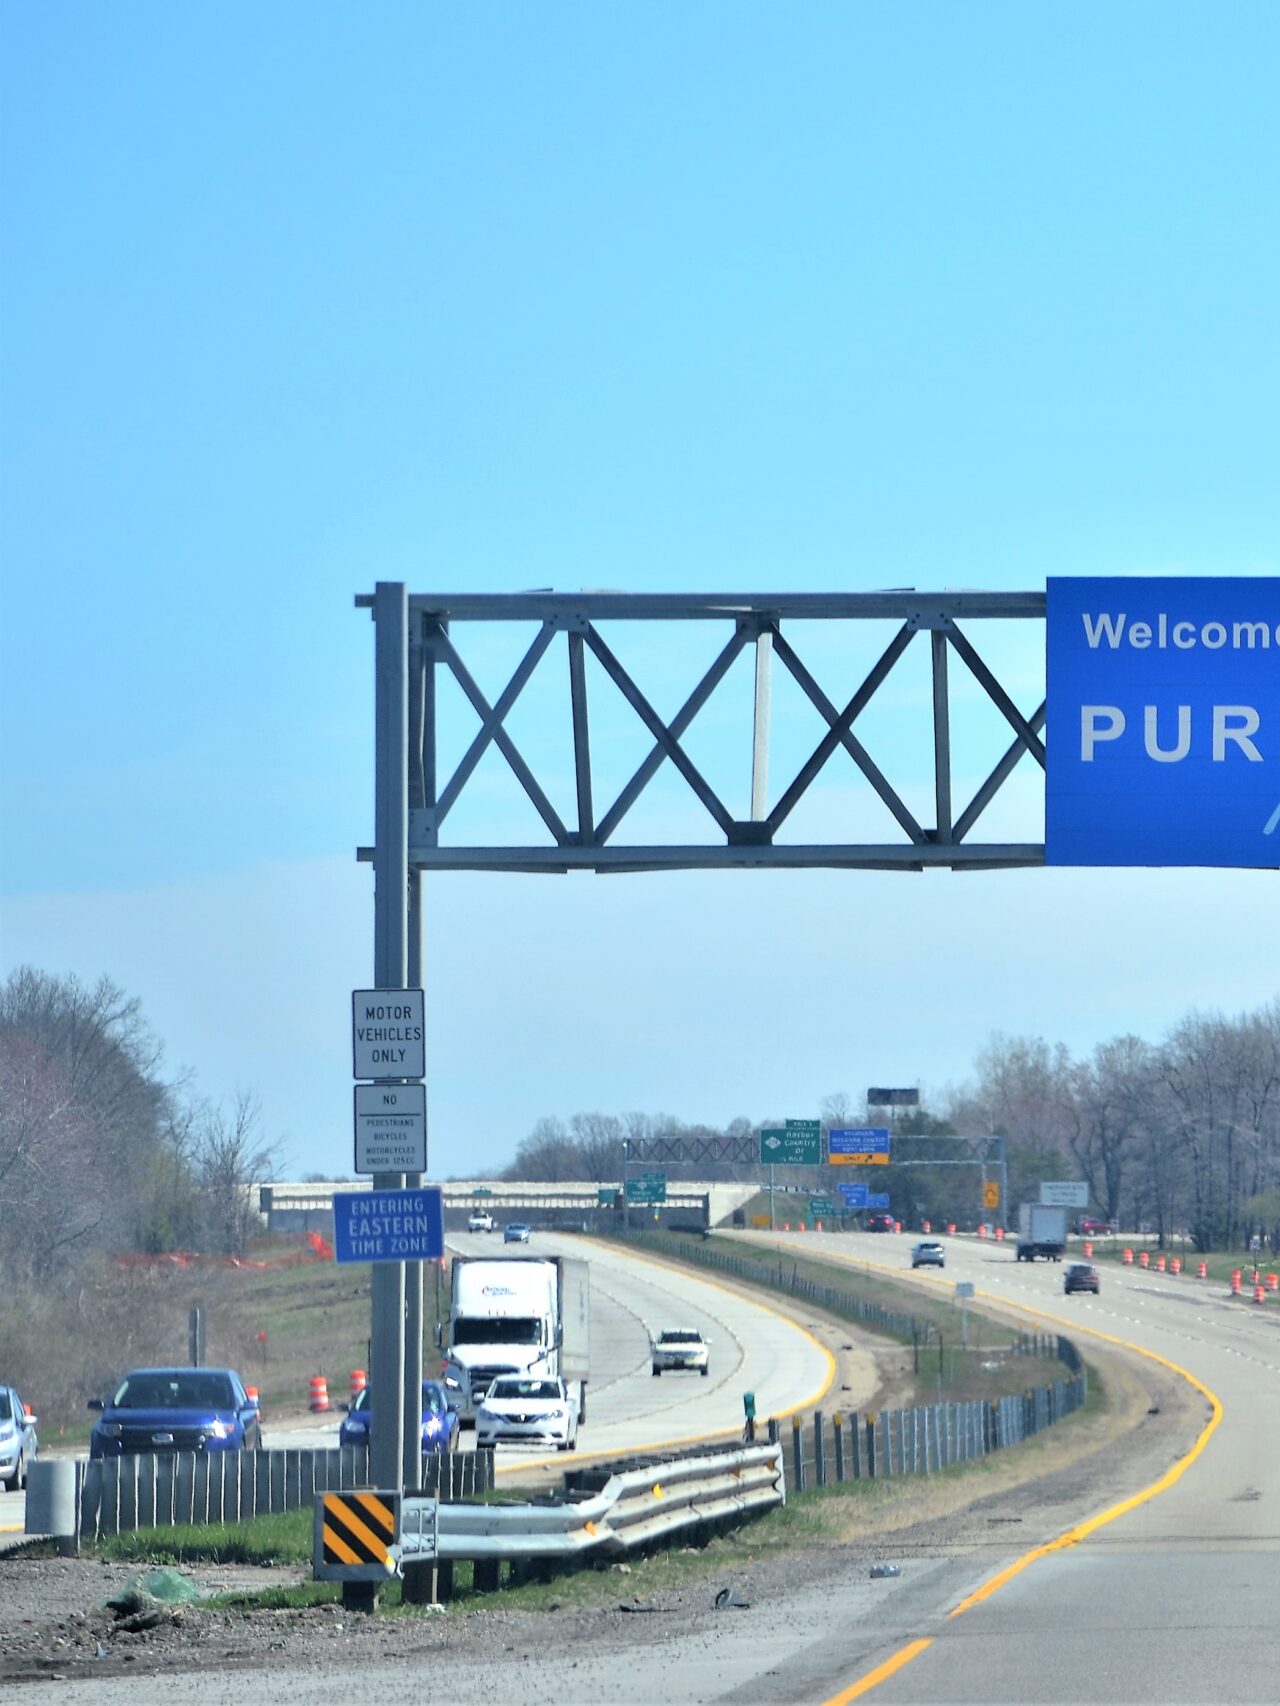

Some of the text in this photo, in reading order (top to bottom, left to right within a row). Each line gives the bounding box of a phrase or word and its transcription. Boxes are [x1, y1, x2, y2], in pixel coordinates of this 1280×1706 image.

[365, 1006, 412, 1020] MOTOR
[357, 1028, 421, 1042] VEHICLES
[372, 1049, 406, 1063] ONLY
[383, 1096, 397, 1106] NO
[366, 1119, 415, 1127] PEDESTRIANS
[374, 1132, 407, 1141] BICYCLES
[786, 1131, 815, 1139] Harbor
[784, 1140, 816, 1148] Country
[351, 1198, 424, 1217] ENTERING
[349, 1218, 428, 1238] EASTERN
[351, 1238, 429, 1256] TIME ZONE
